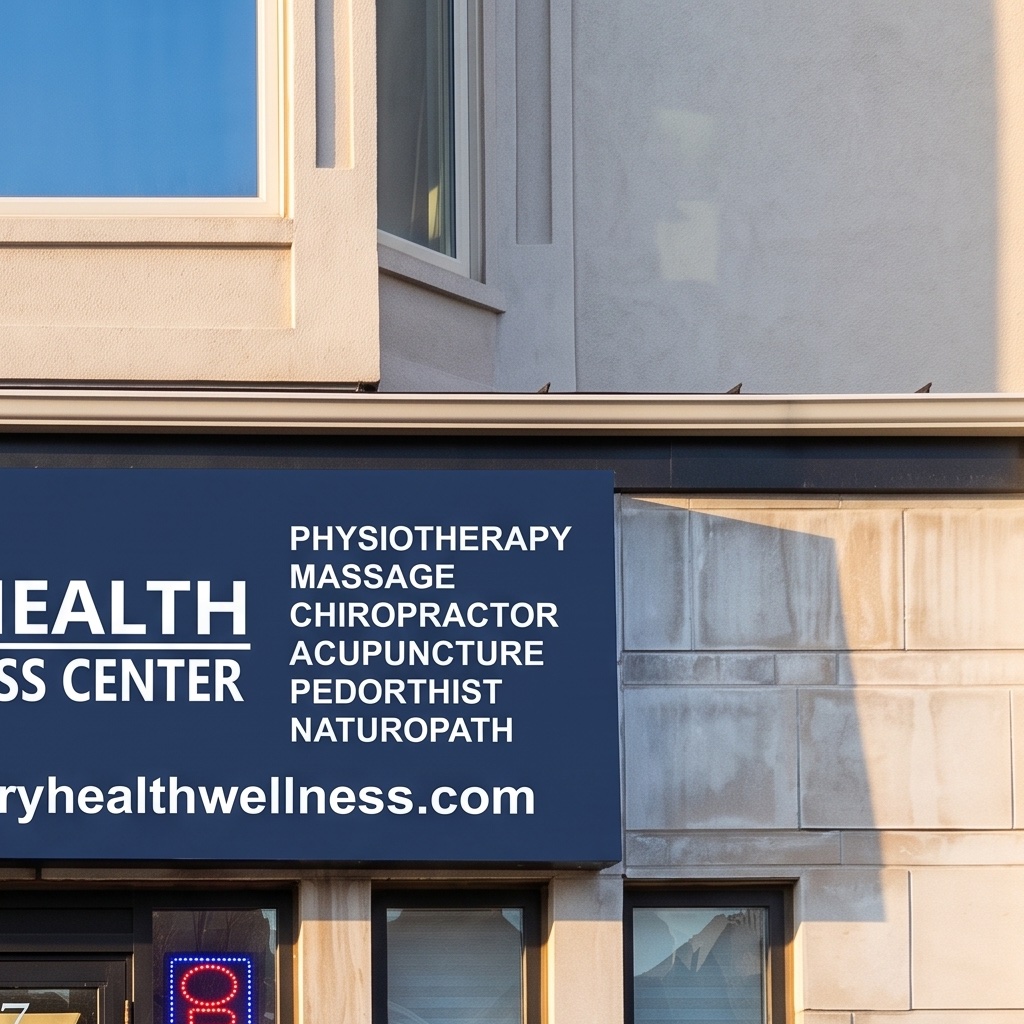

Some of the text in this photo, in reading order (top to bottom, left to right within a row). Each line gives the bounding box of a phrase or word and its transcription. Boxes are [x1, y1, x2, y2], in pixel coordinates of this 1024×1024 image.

[290, 525, 572, 551] PHYSIOTHERAPY
[290, 563, 455, 590] MASSAGE
[290, 601, 559, 628] CHIROPRACTOR
[289, 640, 544, 666] ACUPUNCTURE
[62, 658, 245, 702] CENTER
[291, 678, 503, 705] PEDORTHIST
[291, 716, 513, 743] NATUROPATH
